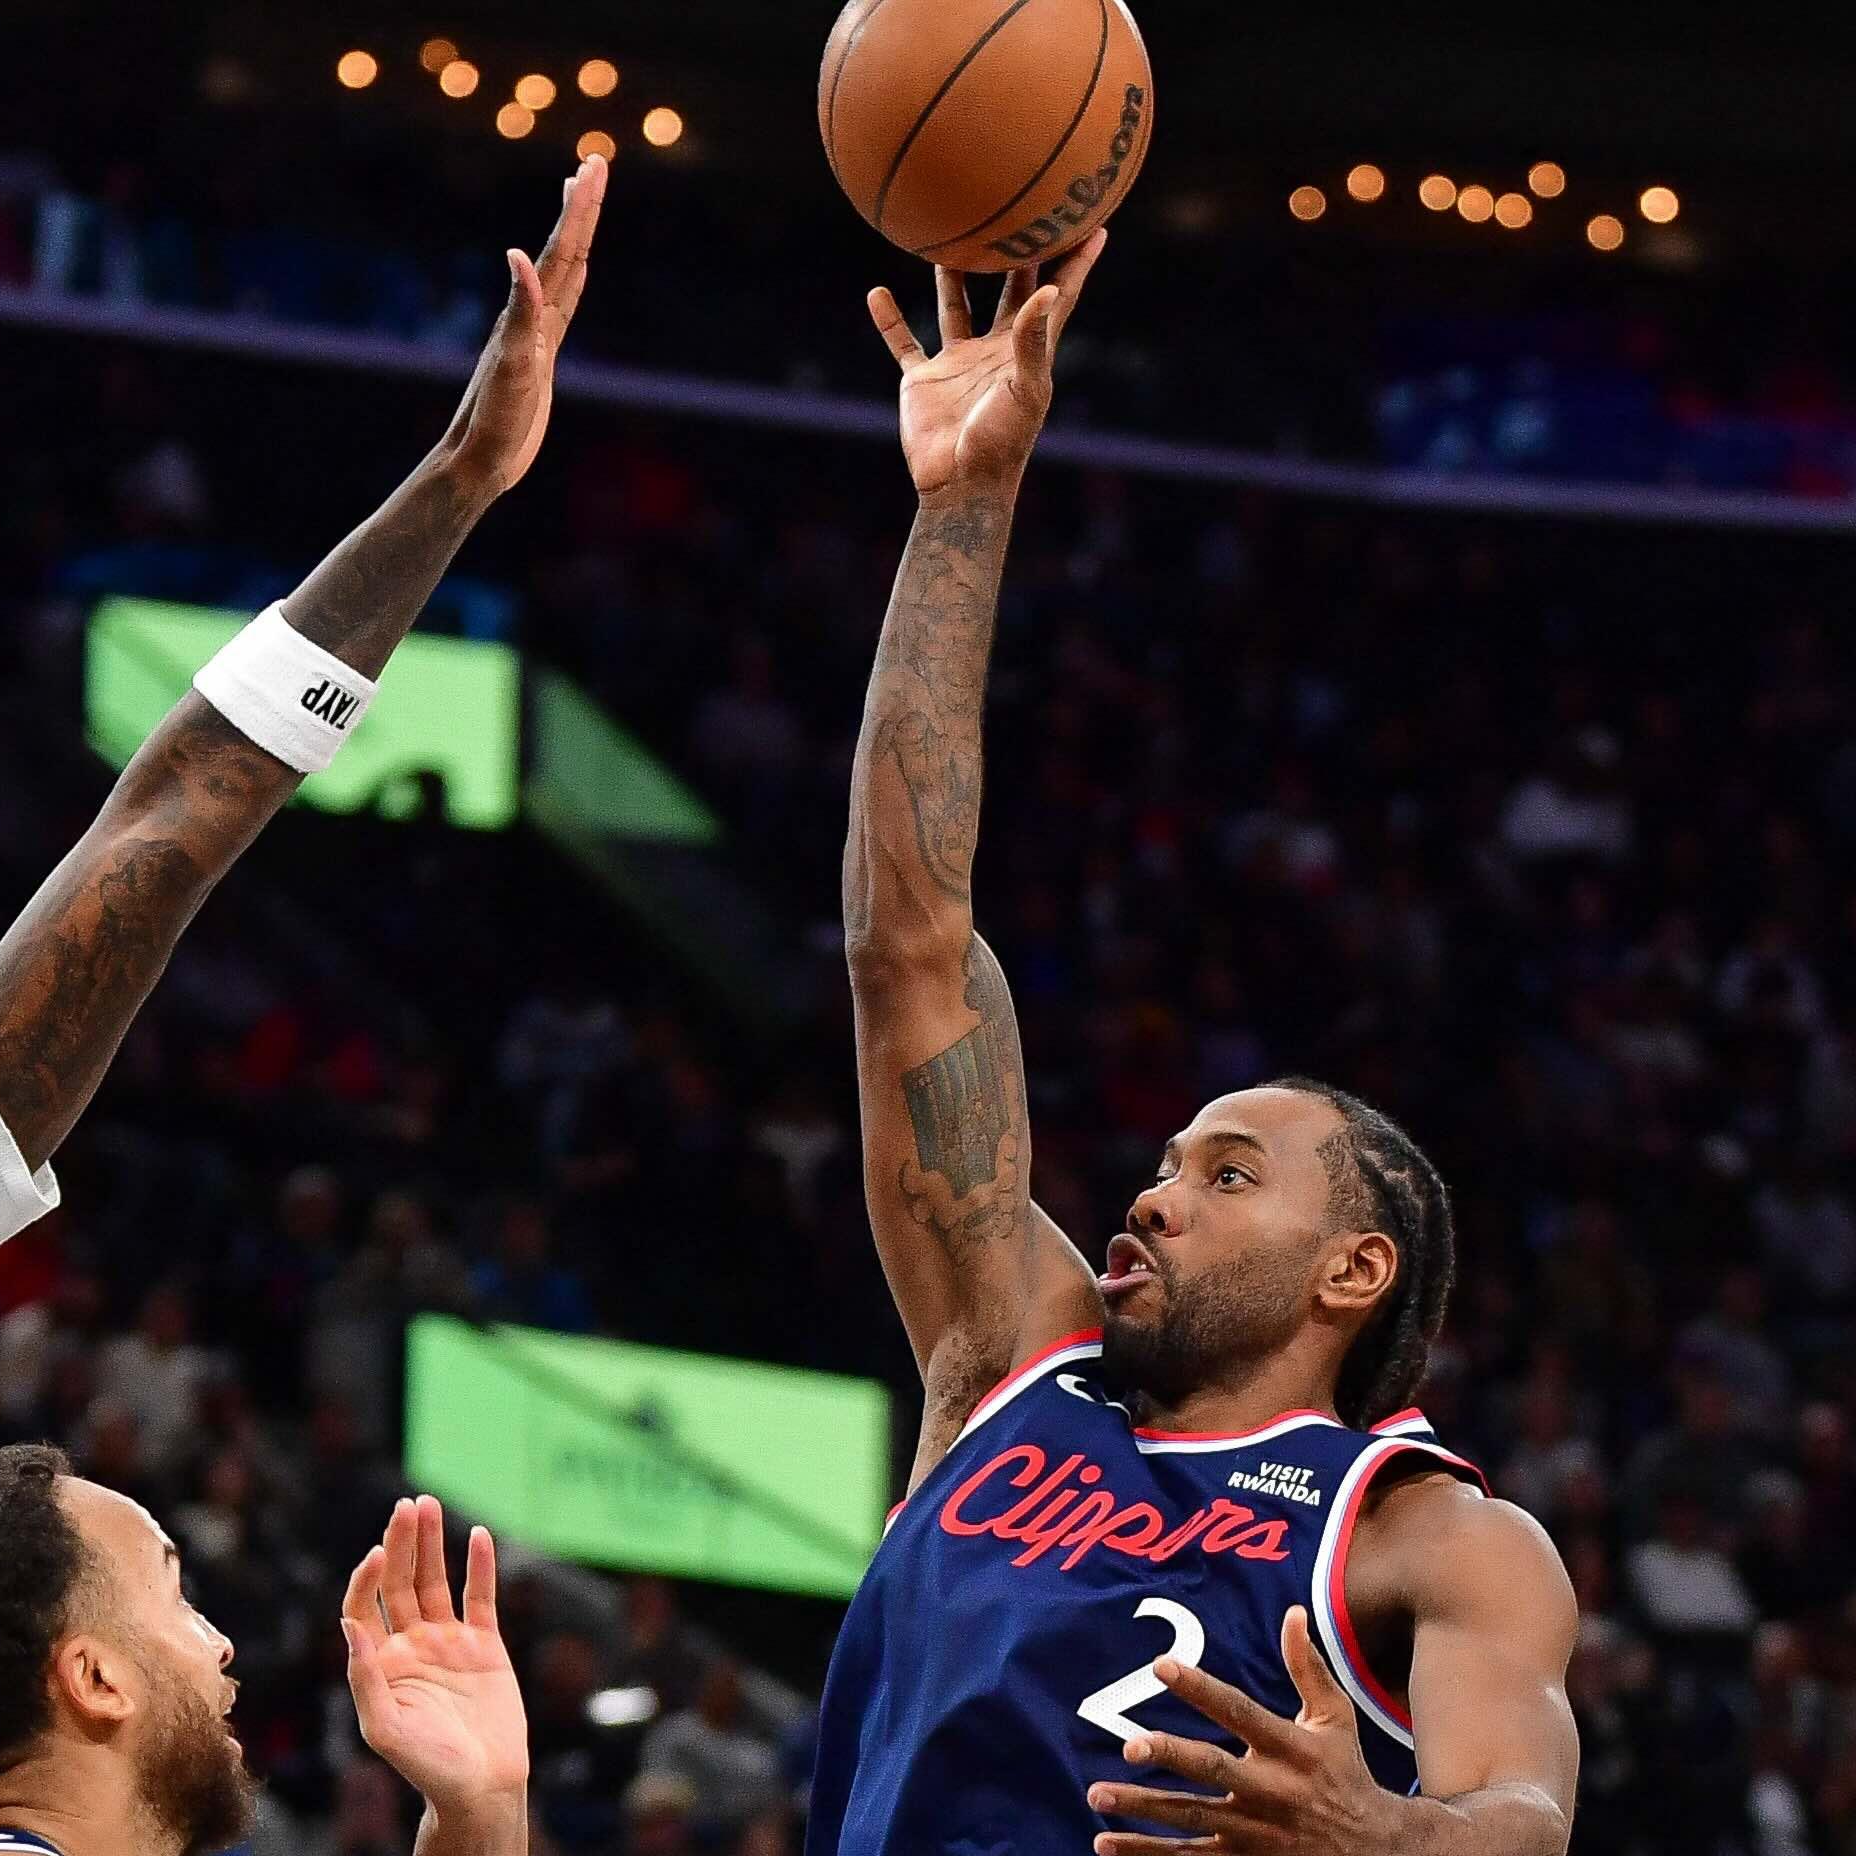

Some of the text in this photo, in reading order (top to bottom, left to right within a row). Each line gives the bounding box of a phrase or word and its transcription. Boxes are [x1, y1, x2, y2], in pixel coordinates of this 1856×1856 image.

[300, 679, 361, 731] TAYP
[1227, 1471, 1322, 1507] RWANDA
[1259, 1461, 1315, 1485] VISIT
[939, 1443, 1292, 1573] Clipprs
[1076, 1596, 1206, 1742] 2
